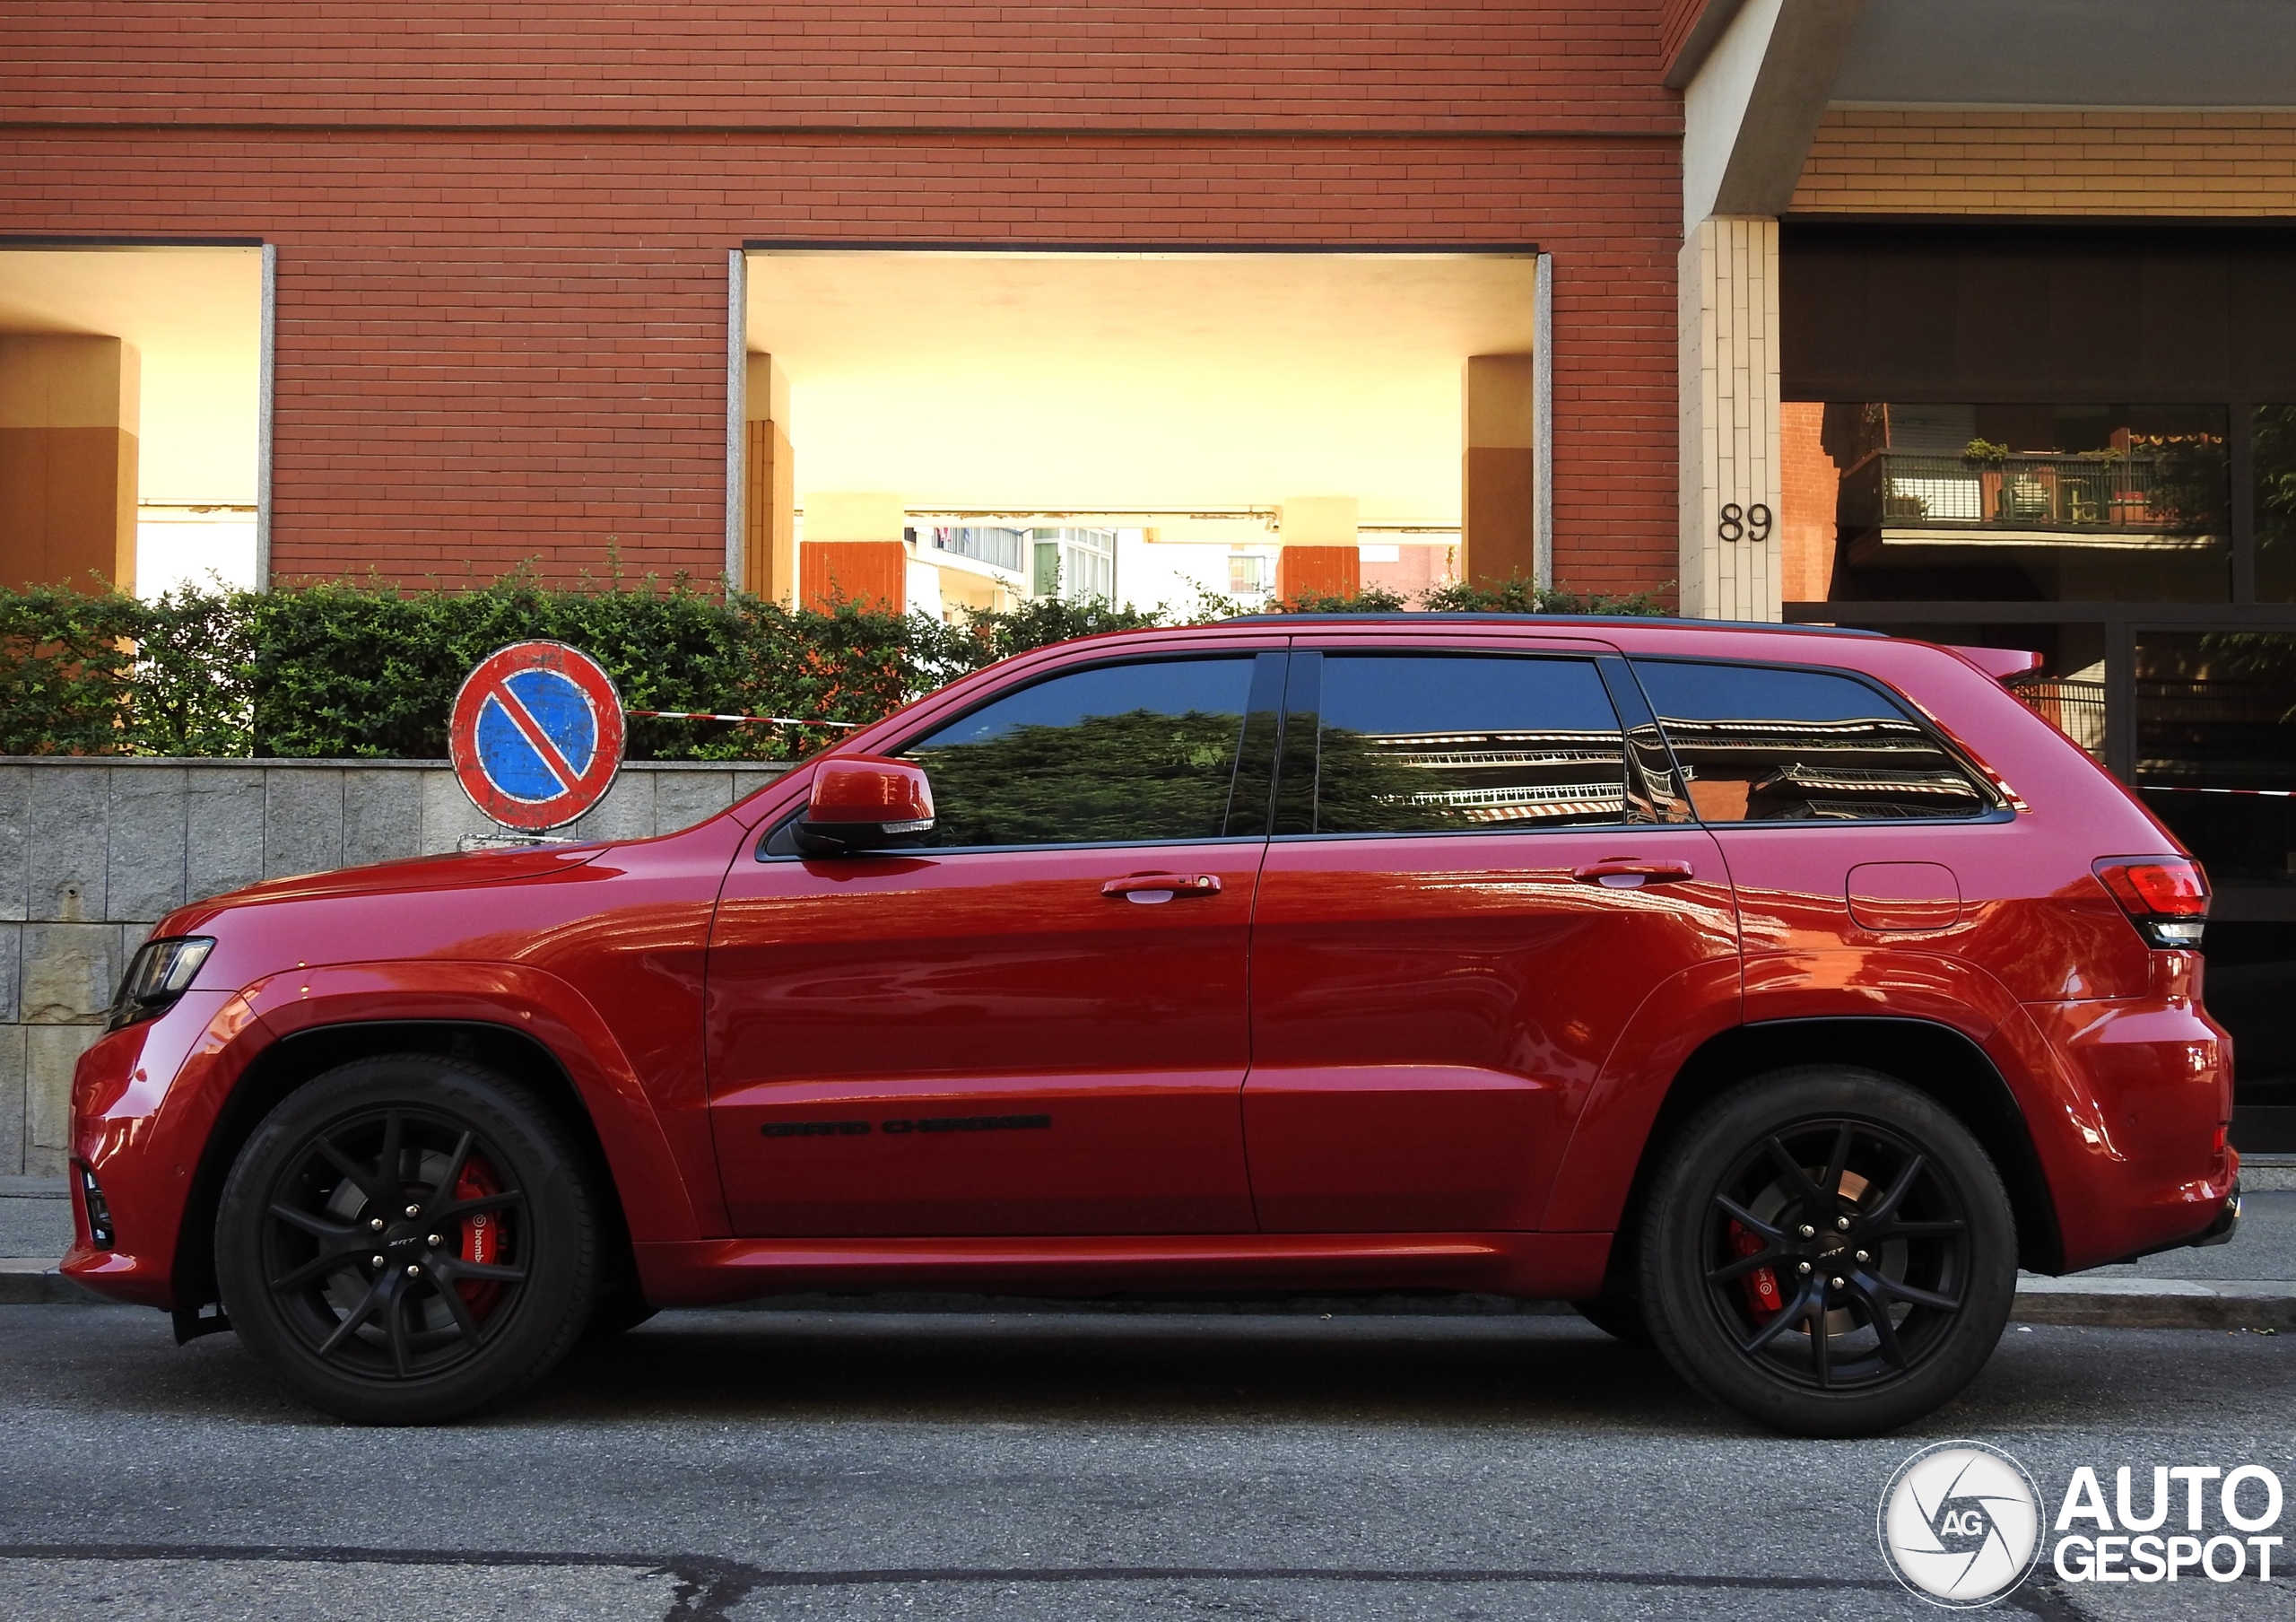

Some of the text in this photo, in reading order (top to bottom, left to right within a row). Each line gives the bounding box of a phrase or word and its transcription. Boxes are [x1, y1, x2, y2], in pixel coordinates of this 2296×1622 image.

[1718, 503, 1772, 542] 89
[761, 1114, 1051, 1137] GRAND CHEROKEE
[388, 1237, 417, 1247] SRT
[474, 1229, 484, 1263] bremb
[1818, 1246, 1845, 1259] SRT
